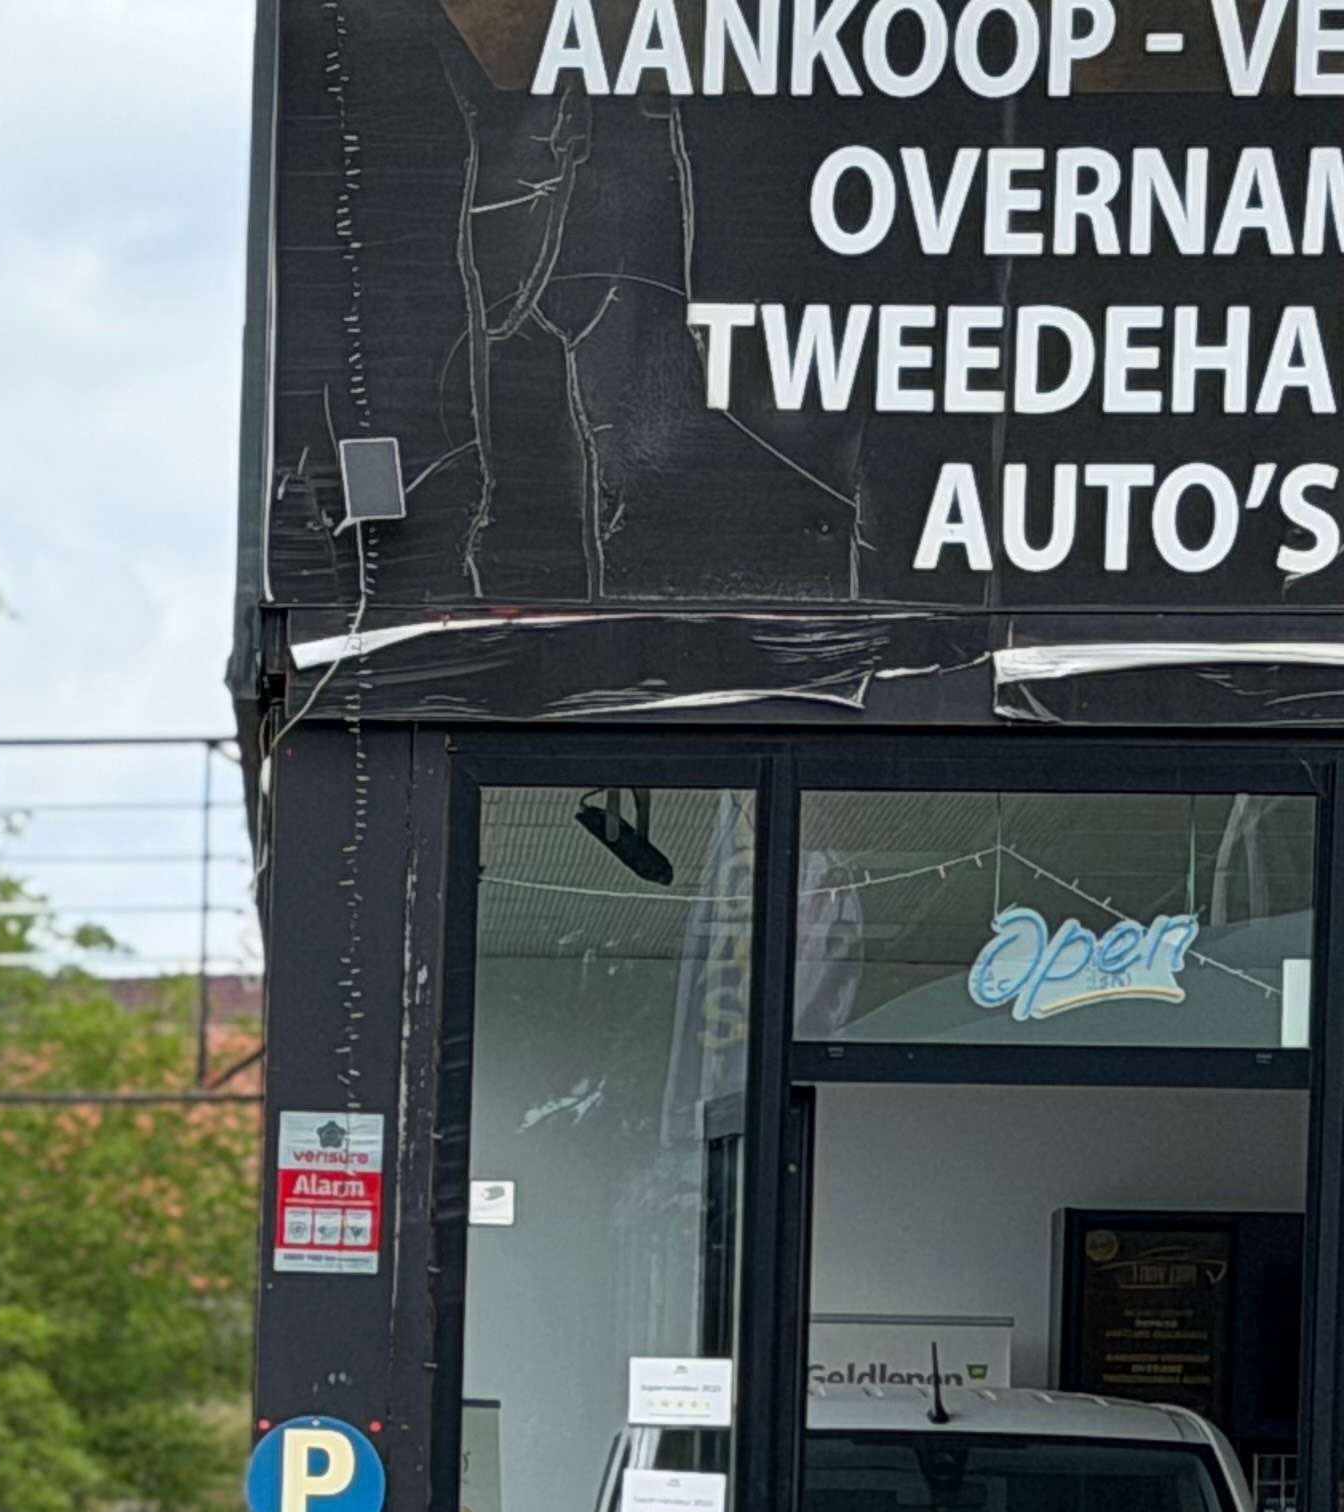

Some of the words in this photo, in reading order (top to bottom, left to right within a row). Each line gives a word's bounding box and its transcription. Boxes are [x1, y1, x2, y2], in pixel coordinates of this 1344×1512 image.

[531, 0, 1116, 98] AANKOOP
[1146, 33, 1183, 51] -
[1211, 0, 1344, 96] VE
[687, 303, 1336, 413] TWEEDEHA
[912, 462, 1340, 573] AUTO'S
[970, 908, 1198, 1020] Open
[293, 1173, 365, 1198] Alarm
